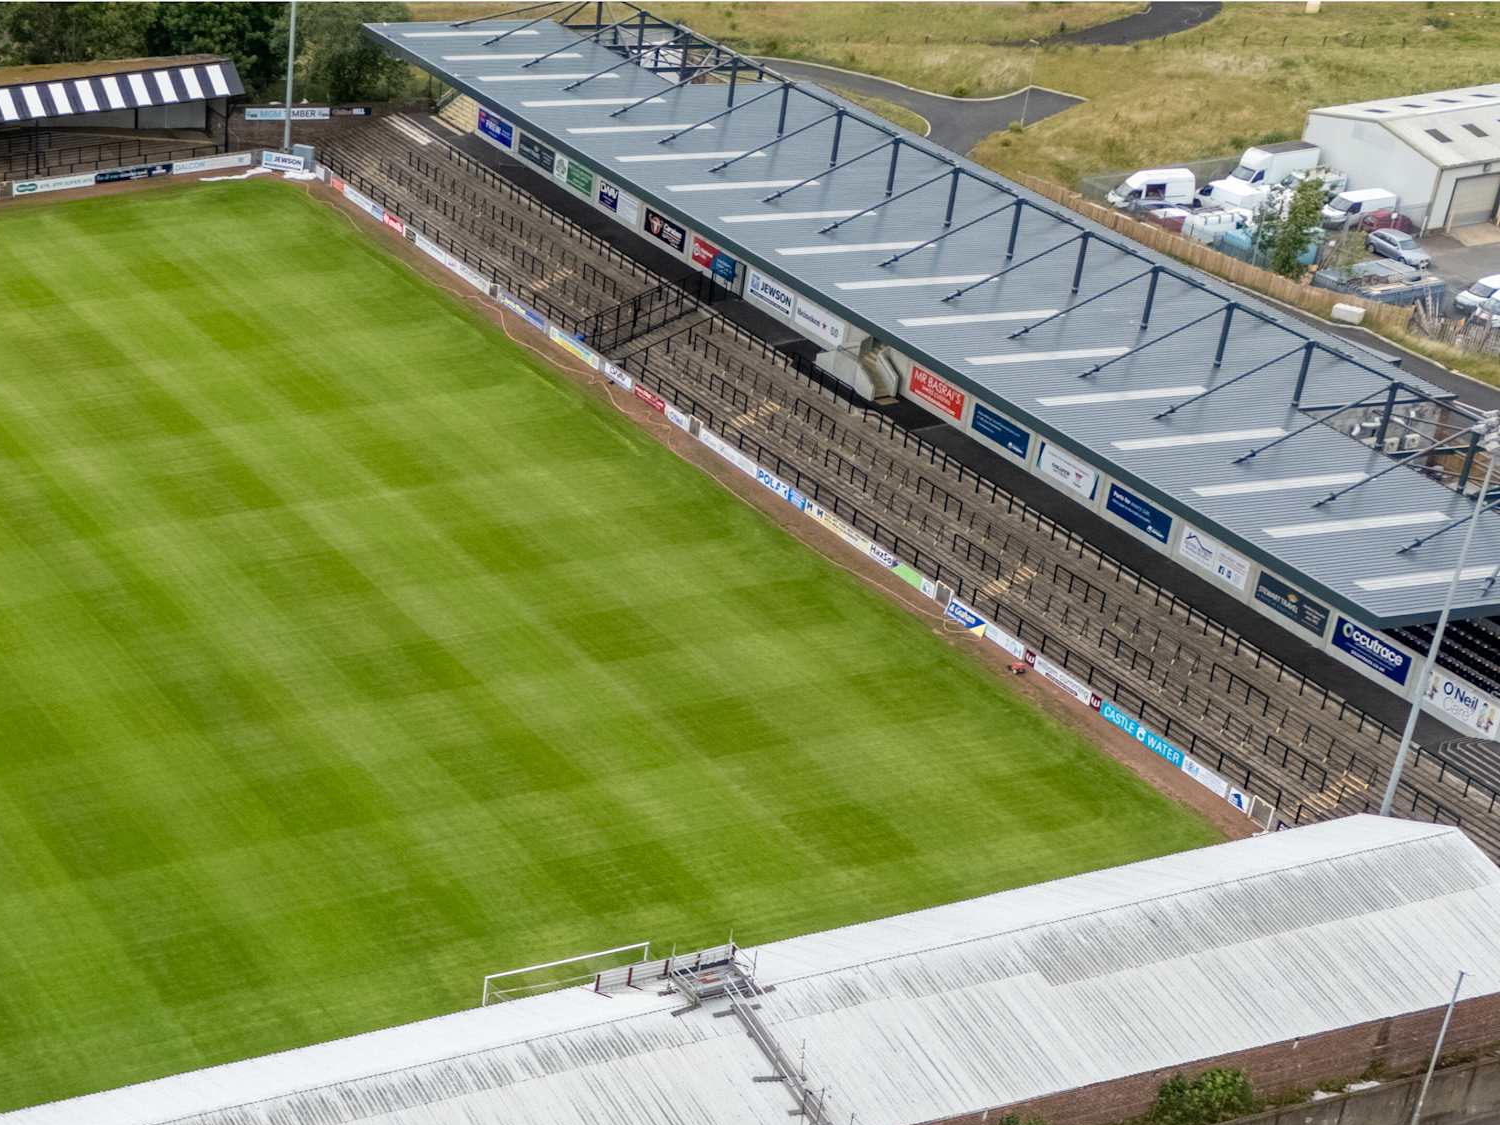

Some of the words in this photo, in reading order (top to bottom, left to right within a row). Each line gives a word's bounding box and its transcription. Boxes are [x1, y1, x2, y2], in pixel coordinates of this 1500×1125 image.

[284, 108, 317, 118] TMBER
[274, 156, 302, 166] JEWSON
[760, 281, 792, 307] JEWSON
[914, 369, 928, 385] MR
[1343, 622, 1403, 666] Occutrace
[1104, 705, 1136, 734] CASTLE
[1147, 735, 1180, 764] WATER
